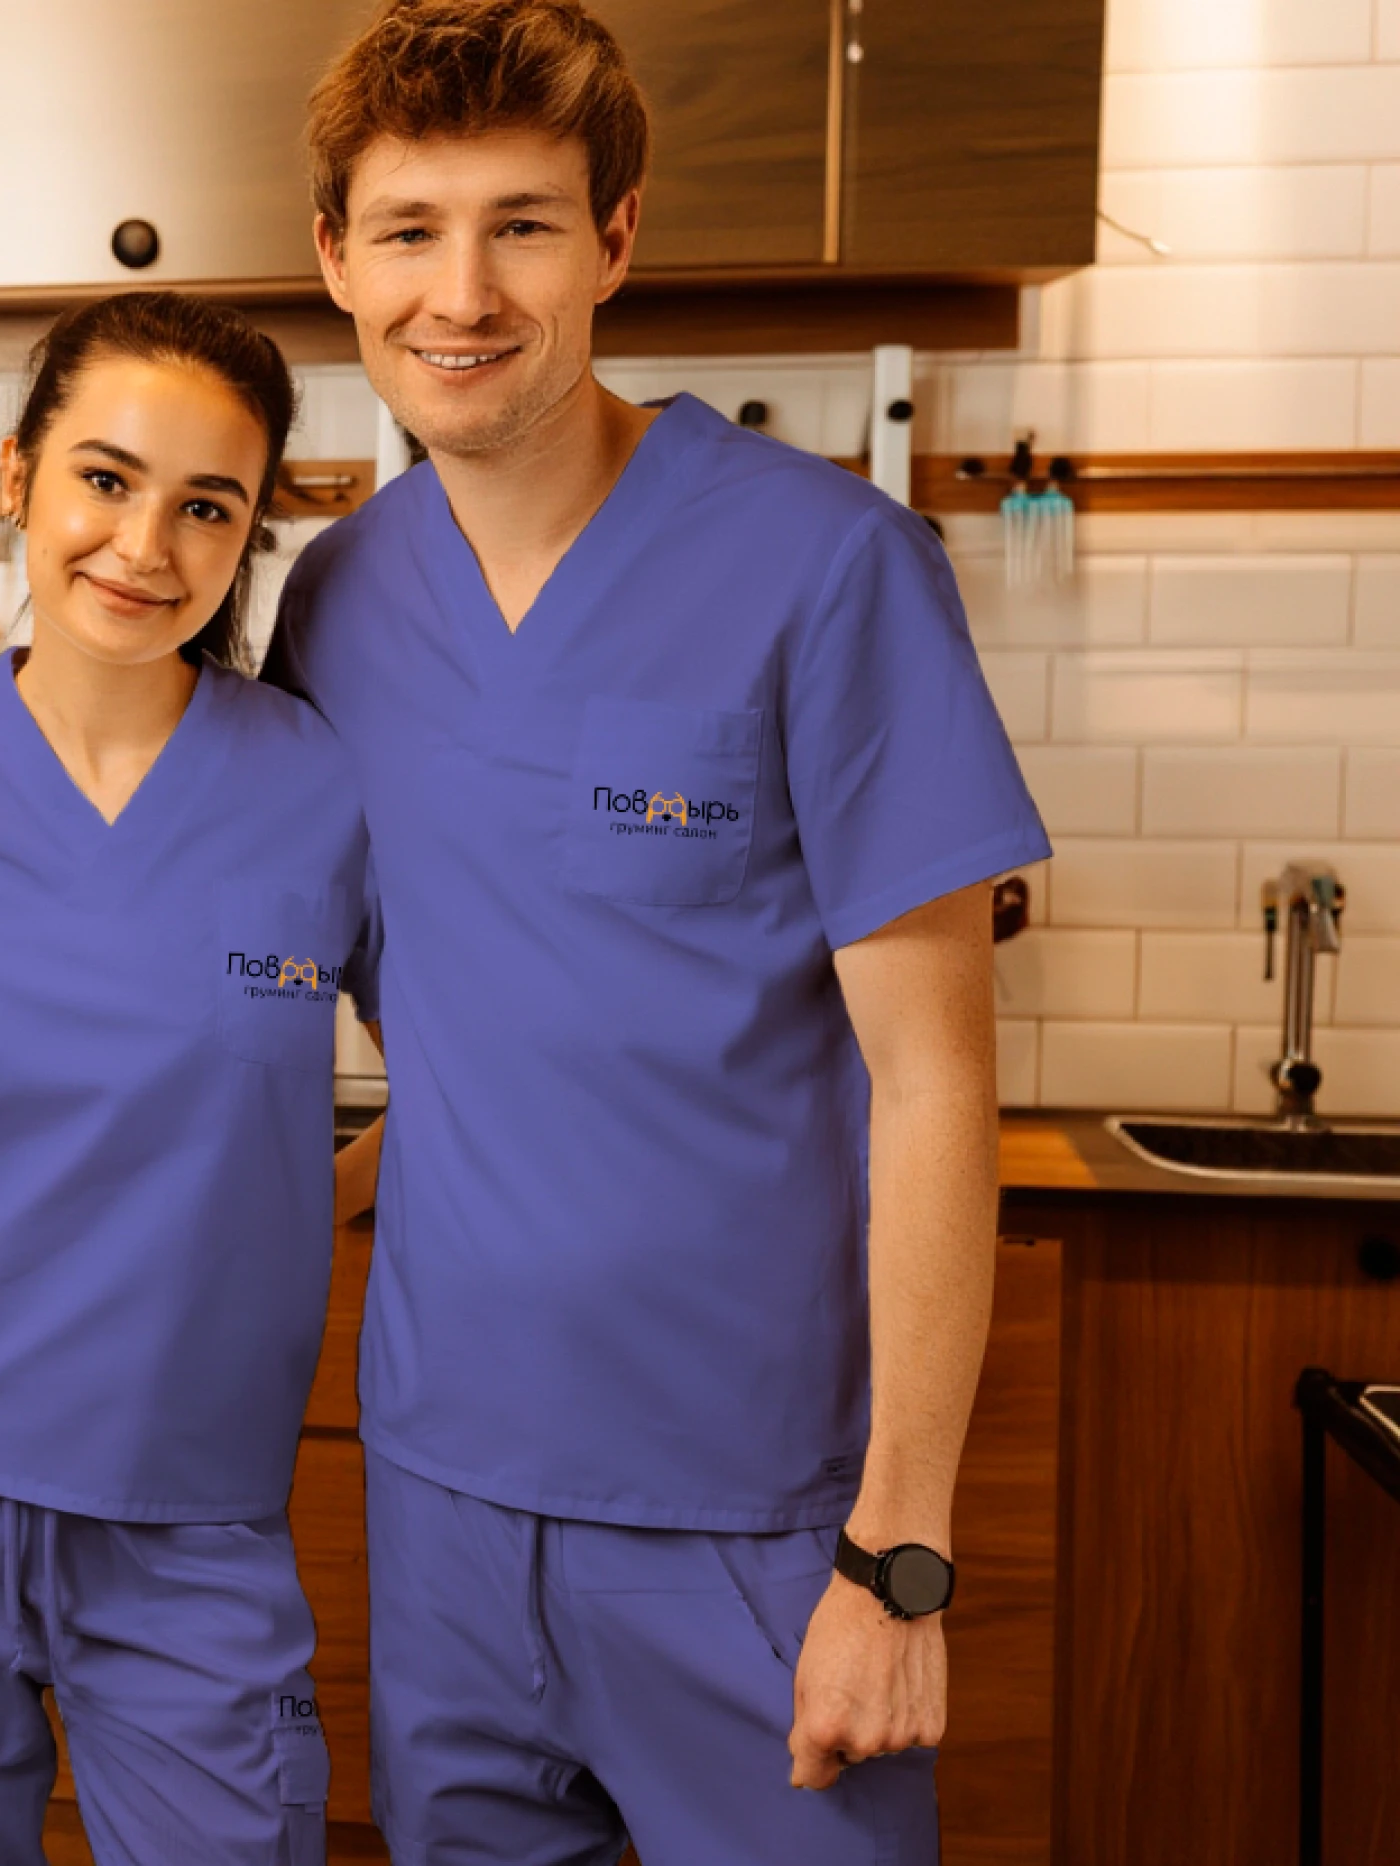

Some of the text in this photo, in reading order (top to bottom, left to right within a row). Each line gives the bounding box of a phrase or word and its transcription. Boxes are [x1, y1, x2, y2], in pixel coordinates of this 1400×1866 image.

[610, 822, 718, 839] груминг салон
[305, 991, 337, 1003] сало
